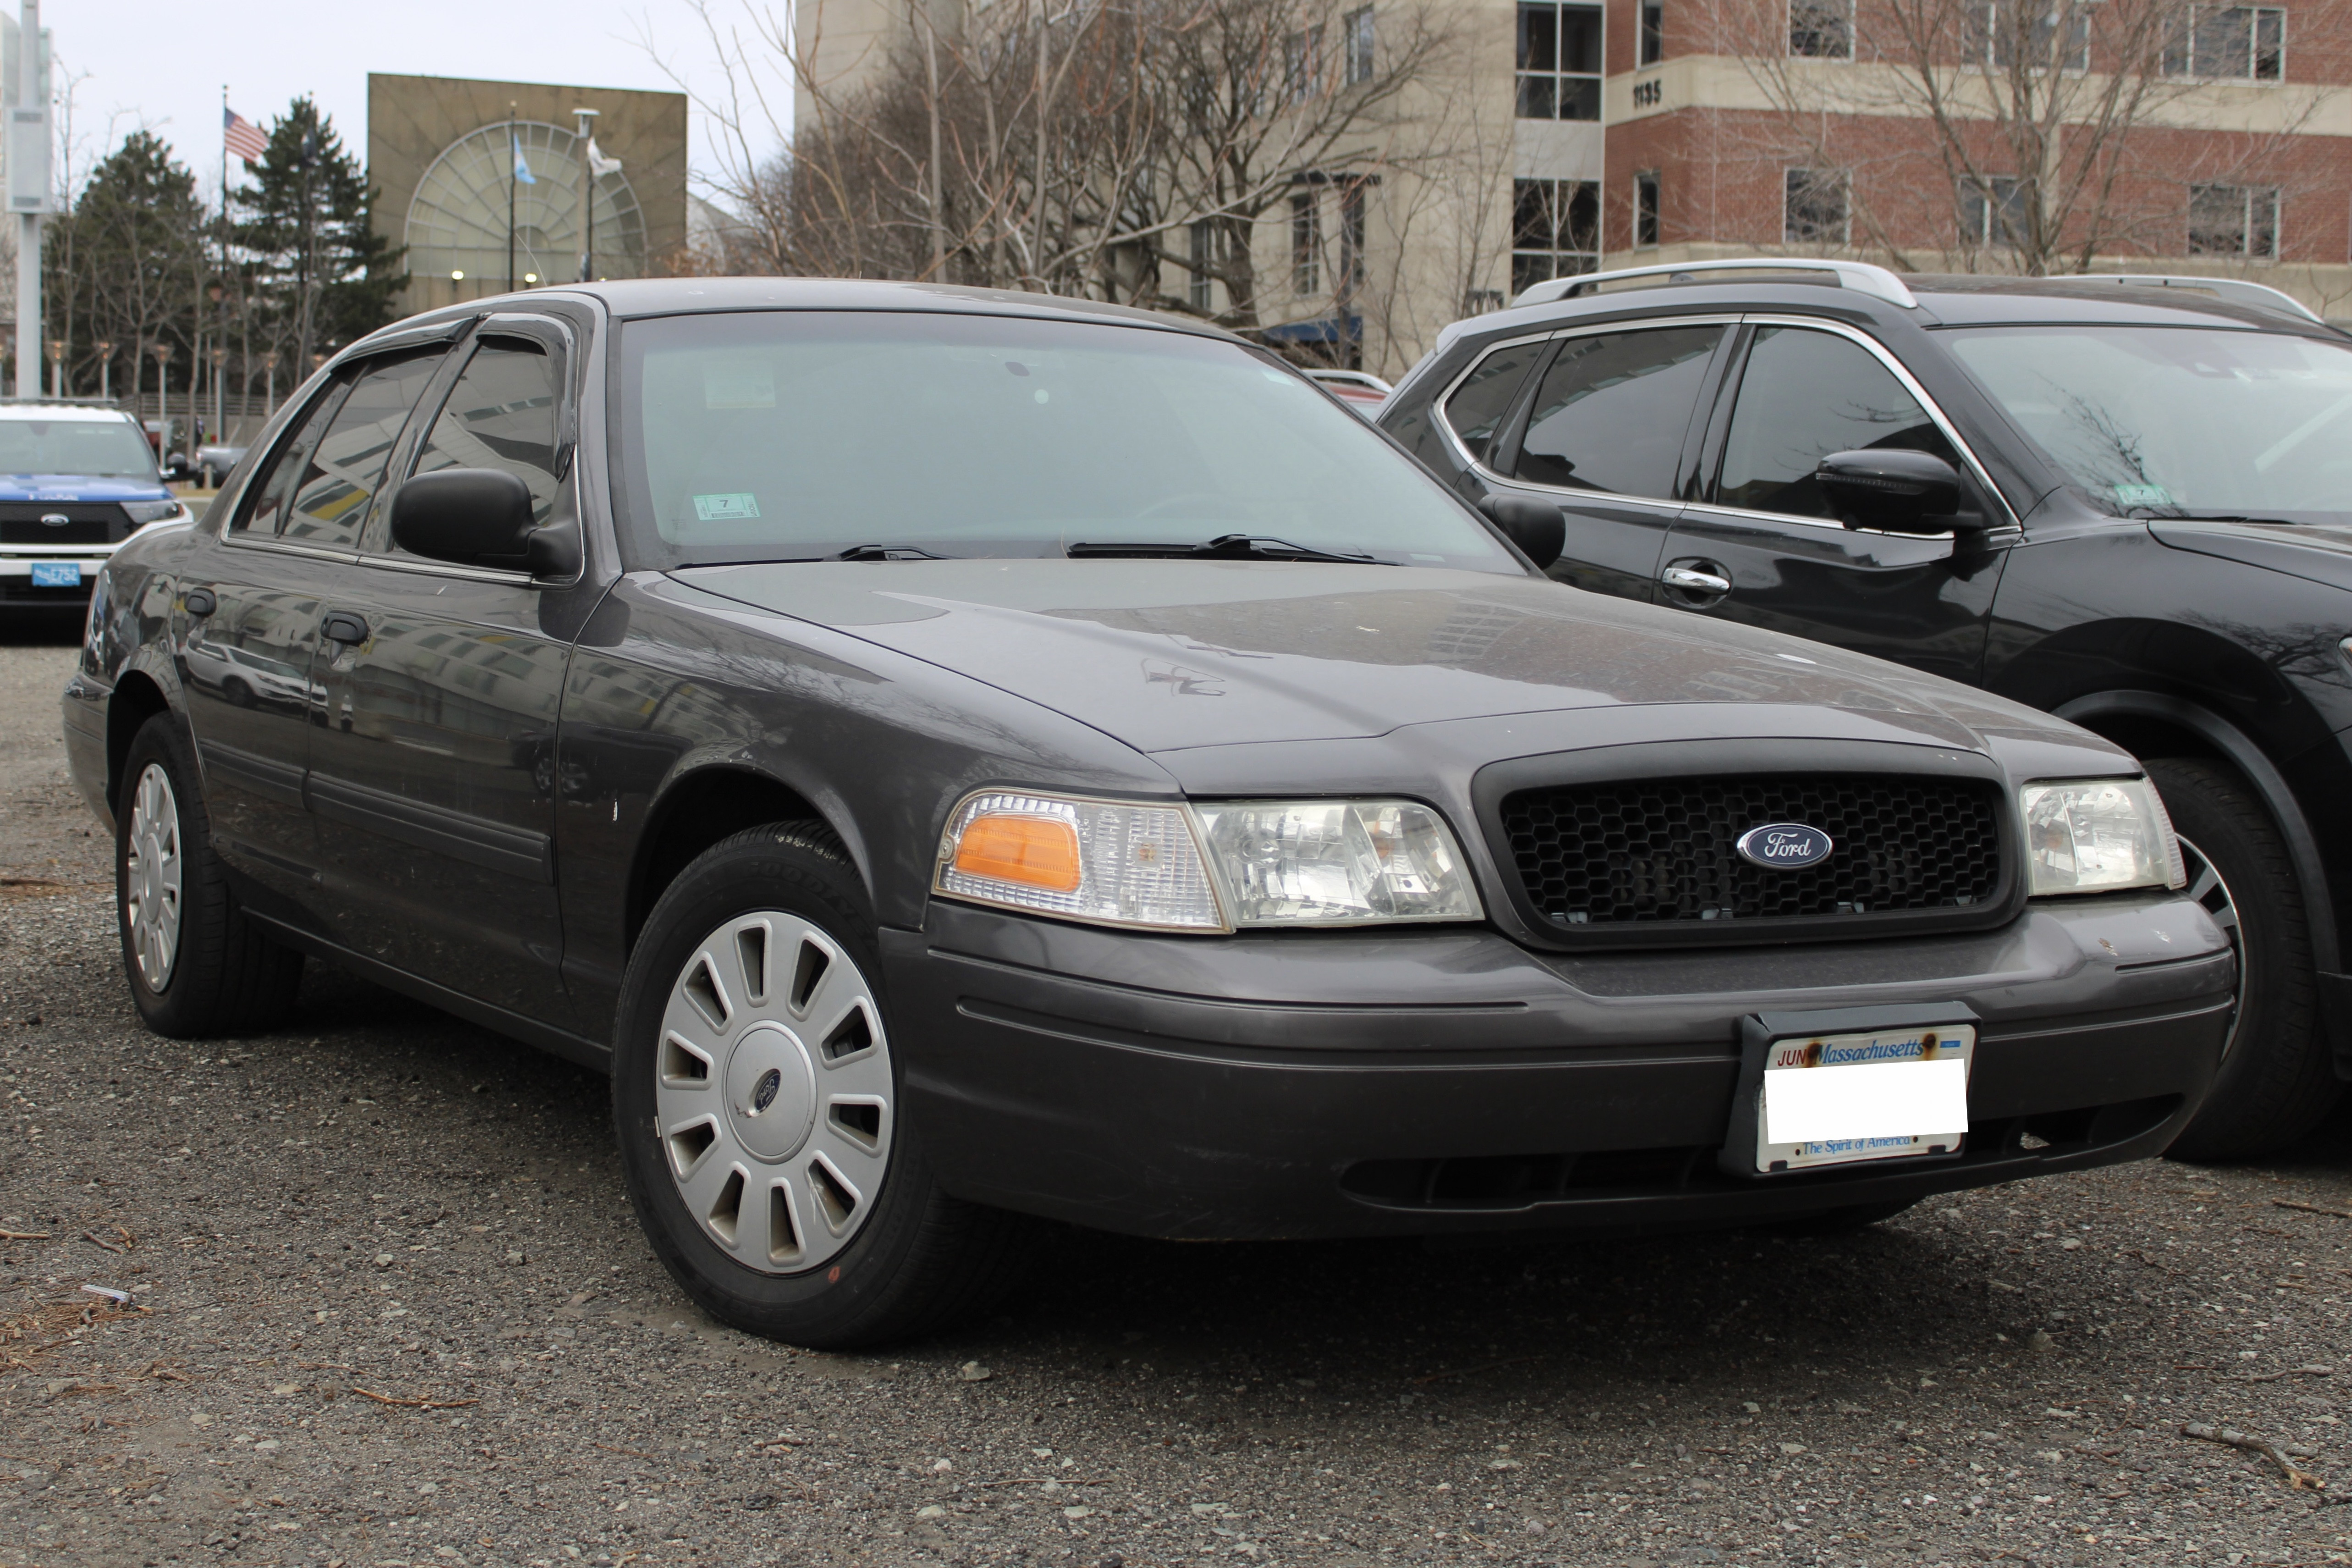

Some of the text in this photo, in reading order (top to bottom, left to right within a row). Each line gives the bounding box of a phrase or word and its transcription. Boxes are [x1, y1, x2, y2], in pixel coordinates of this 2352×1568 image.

[1634, 78, 1662, 110] 1135
[719, 499, 729, 508] 7
[1764, 832, 1812, 858] Ford
[1778, 1049, 1808, 1066] JUN
[1815, 1039, 1925, 1065] Massachusetts
[758, 1078, 776, 1105] Ford
[1803, 1136, 1910, 1154] The Spirit of America
